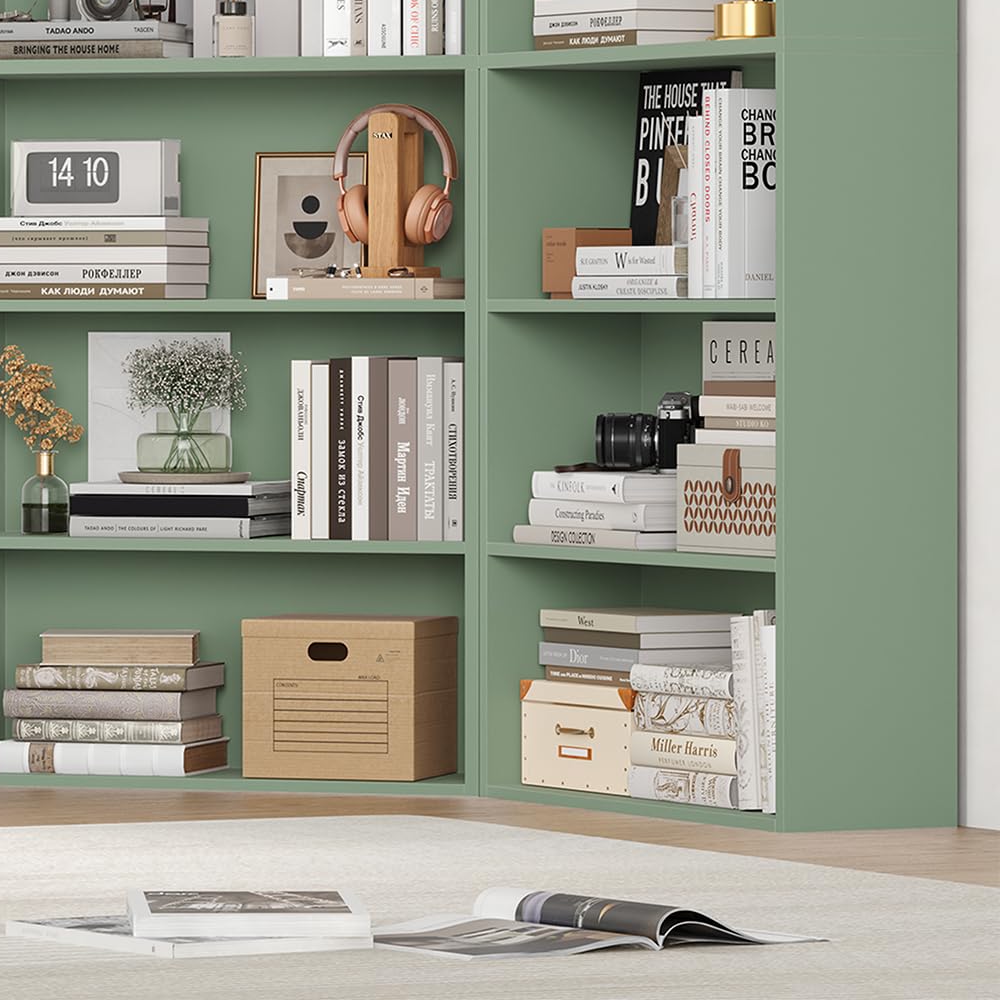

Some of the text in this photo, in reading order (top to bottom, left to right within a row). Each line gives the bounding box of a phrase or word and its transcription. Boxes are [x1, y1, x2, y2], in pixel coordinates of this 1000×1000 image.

[410, 10, 419, 24] OF
[72, 26, 94, 34] ANDO
[410, 25, 419, 49] CHIC
[569, 37, 580, 45] КАК
[600, 34, 626, 44] ДУМАЮТ
[13, 44, 120, 54] BRINGING THE HOUSE HOME
[643, 83, 699, 110] THE HOUSE
[48, 157, 109, 187] 14 10
[27, 269, 59, 277] ДЭВИСОН
[82, 269, 142, 280] РОКФЕЛЛЕР
[745, 273, 774, 281] DANIEL
[40, 286, 61, 296] КАК
[63, 286, 95, 297] ЛЮДИ
[99, 286, 145, 297] ДУМАЮТ
[709, 340, 775, 364] CEREA
[425, 374, 436, 446] Иммануил Кант
[449, 424, 457, 500] СТИХОТВОРЕНИЯ
[395, 442, 410, 514] Мартин Иден
[295, 470, 308, 516] Спартак
[424, 461, 436, 520] ТРАКТАТЫ
[577, 615, 594, 627] West
[569, 648, 589, 664] Dior
[651, 736, 718, 759] Miller Harris
